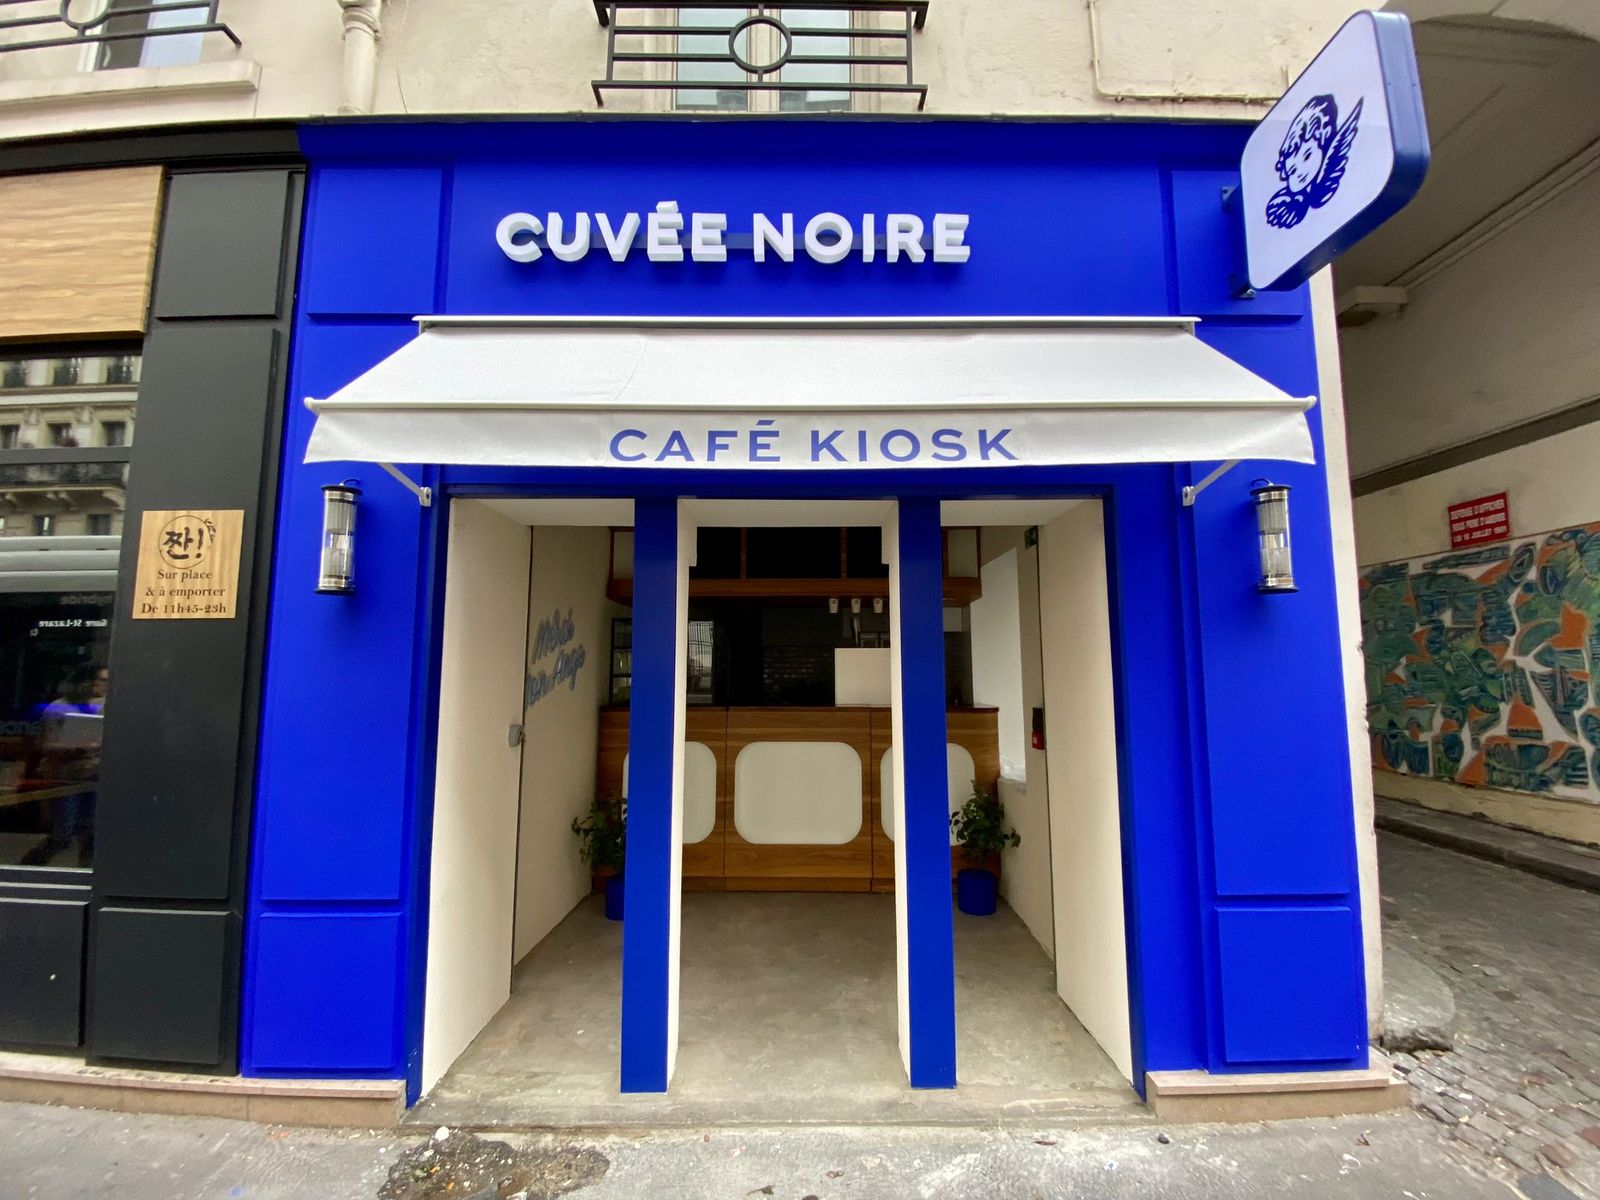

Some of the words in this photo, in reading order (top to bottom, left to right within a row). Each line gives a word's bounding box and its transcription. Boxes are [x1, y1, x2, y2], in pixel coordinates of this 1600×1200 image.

[495, 200, 728, 263] CUVÉE
[753, 212, 970, 264] NOIRE
[609, 420, 780, 463] CAFÉ
[810, 429, 1019, 463] KIOSK
[157, 569, 178, 580] Sur
[181, 568, 213, 583] place
[145, 586, 155, 597] &
[159, 586, 166, 597] à
[169, 587, 226, 600] emporter
[142, 603, 159, 614] De
[164, 602, 227, 614] 11h45-23h
